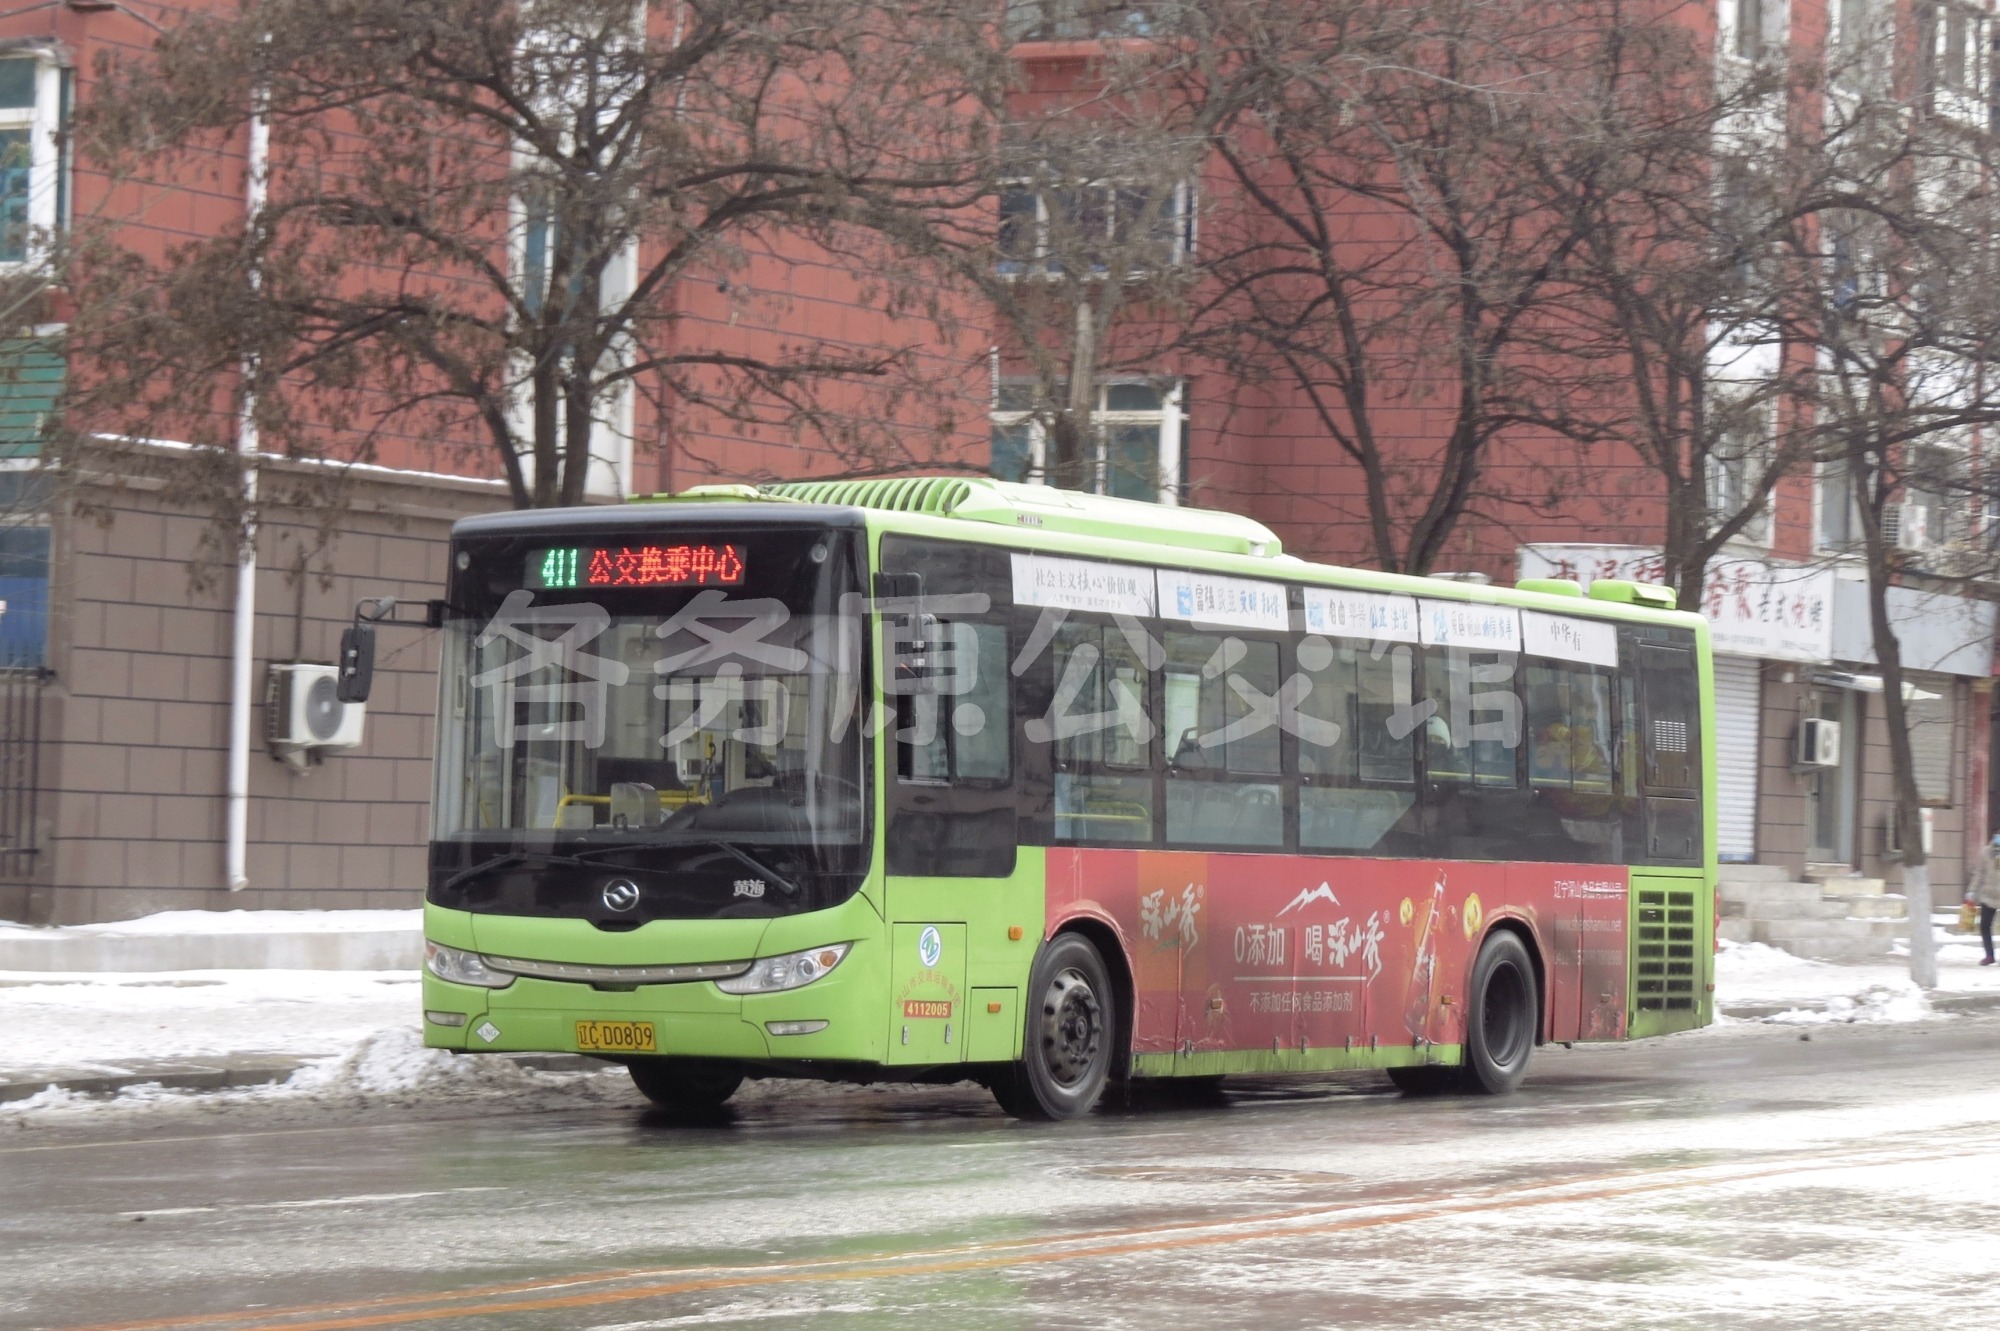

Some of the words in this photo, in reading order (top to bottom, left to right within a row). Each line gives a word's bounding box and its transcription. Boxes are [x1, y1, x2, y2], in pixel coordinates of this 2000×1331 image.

[541, 548, 578, 587] 411
[588, 545, 743, 585] 公交换乘中心
[1035, 567, 1137, 596] 社会主义核心价值观
[732, 878, 766, 898] 黄海
[907, 1002, 948, 1016] 4112005
[1249, 990, 1353, 1013] 不添加任何食品添加剂
[480, 1027, 497, 1037] LNG
